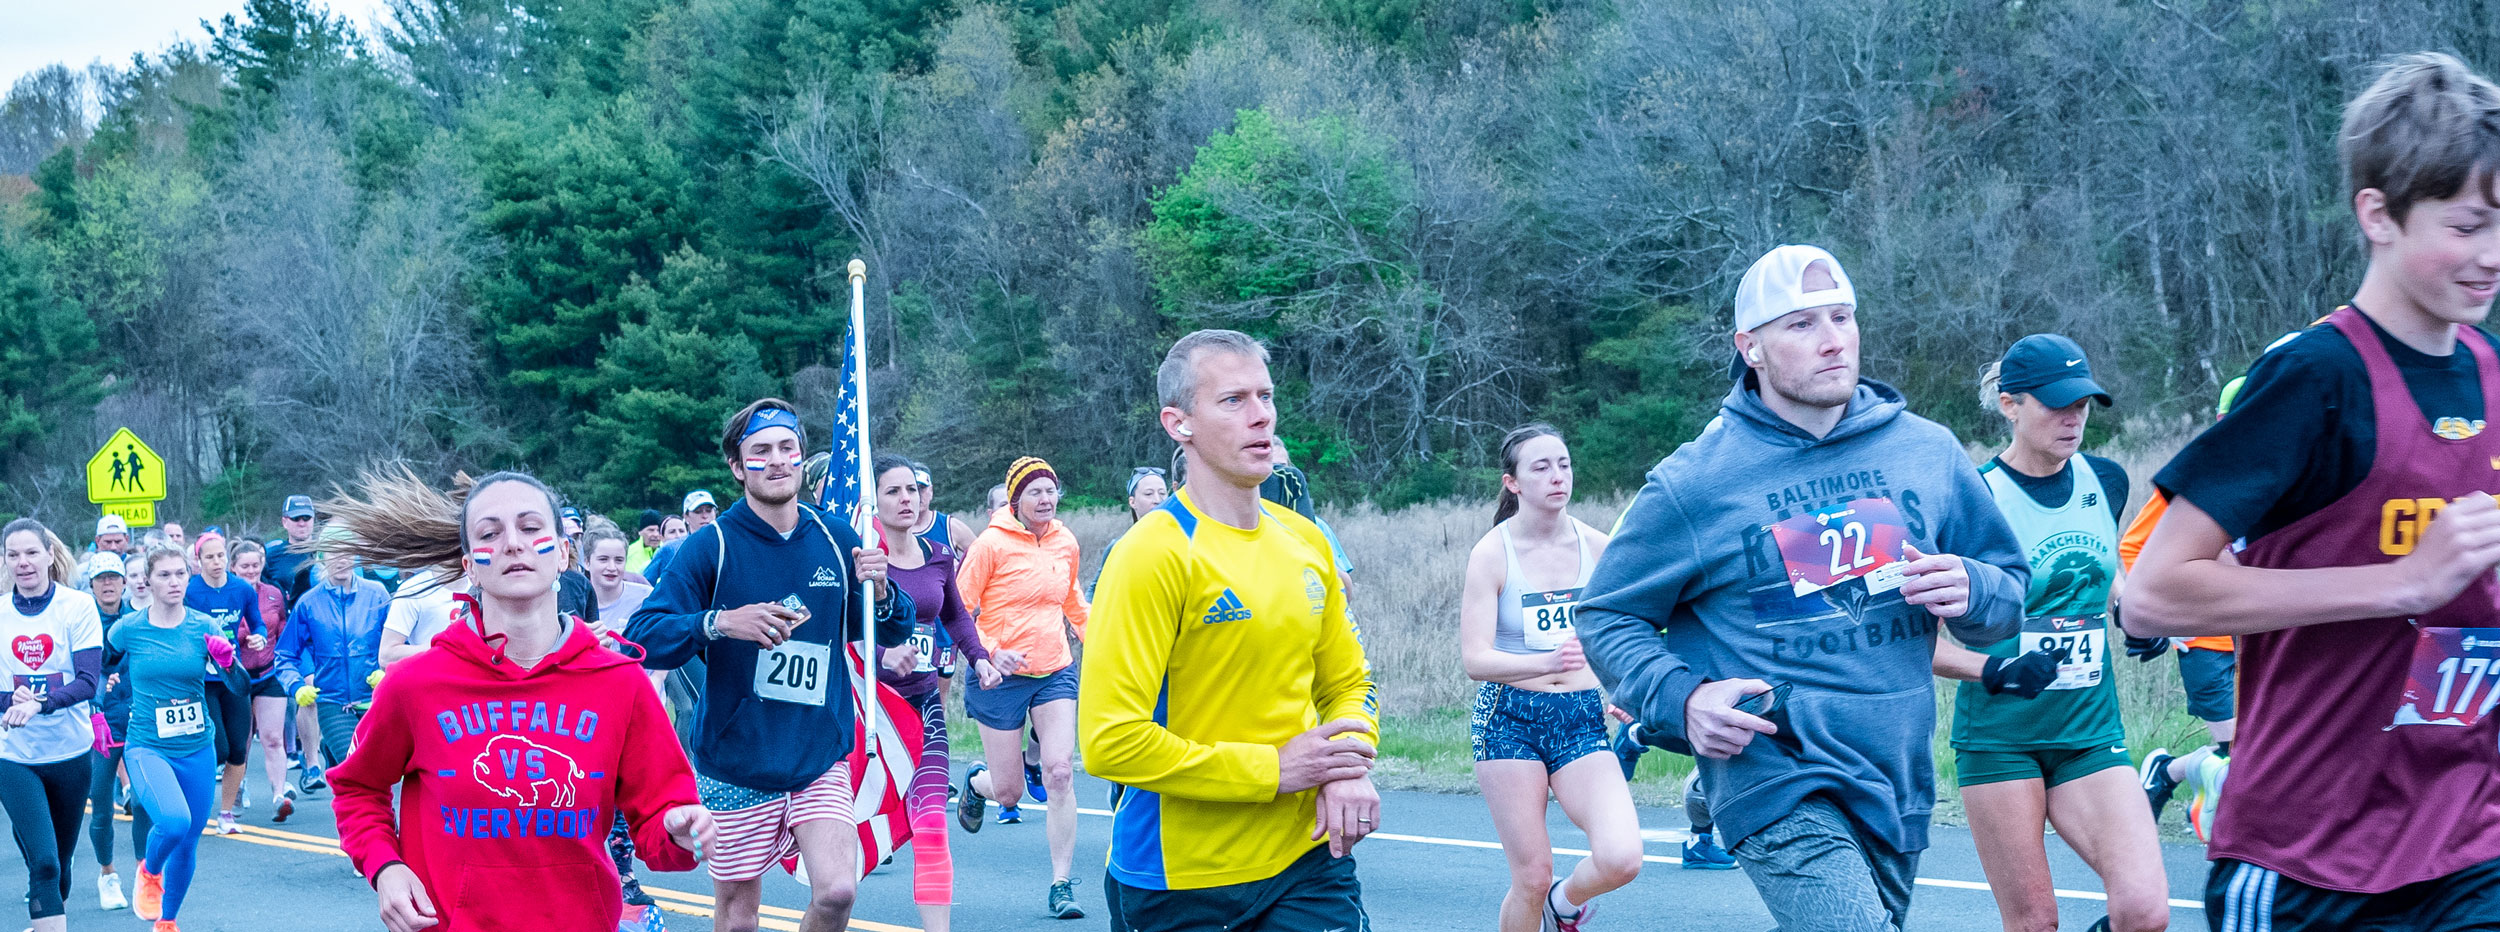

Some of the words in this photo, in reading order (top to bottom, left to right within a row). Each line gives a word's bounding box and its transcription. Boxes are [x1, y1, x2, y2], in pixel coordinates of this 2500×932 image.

[1766, 469, 1887, 511] BALTIMORE
[1819, 521, 1875, 577] 22
[2028, 535, 2108, 569] MANCHESTER
[1203, 609, 1252, 624] adidas
[1771, 611, 1940, 661] FOOTBALL
[767, 652, 818, 691] 209
[165, 706, 196, 724] 813
[436, 700, 599, 744] BUFFALO
[498, 749, 546, 780] VS
